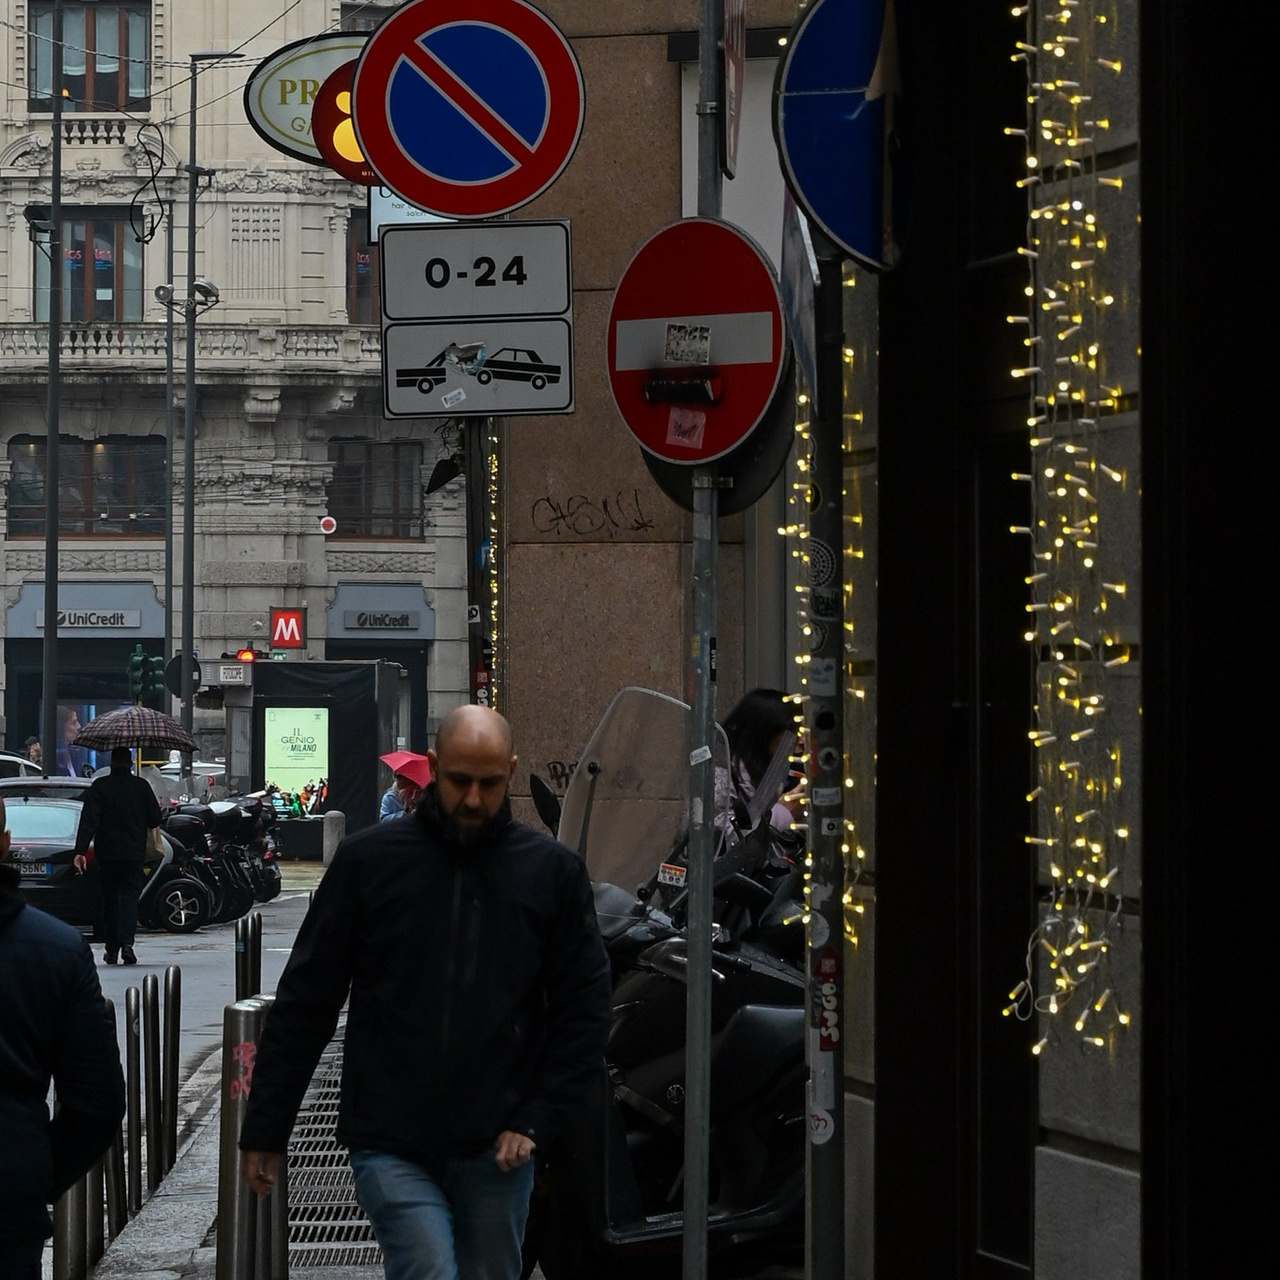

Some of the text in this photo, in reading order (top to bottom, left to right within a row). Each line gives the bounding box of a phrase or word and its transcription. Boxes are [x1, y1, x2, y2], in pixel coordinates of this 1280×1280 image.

[425, 256, 527, 288] 0-24
[68, 612, 125, 626] UniCredit
[369, 613, 410, 627] UniCredit
[274, 618, 300, 640] M
[281, 736, 315, 744] GENIO
[290, 744, 317, 752] MILANO
